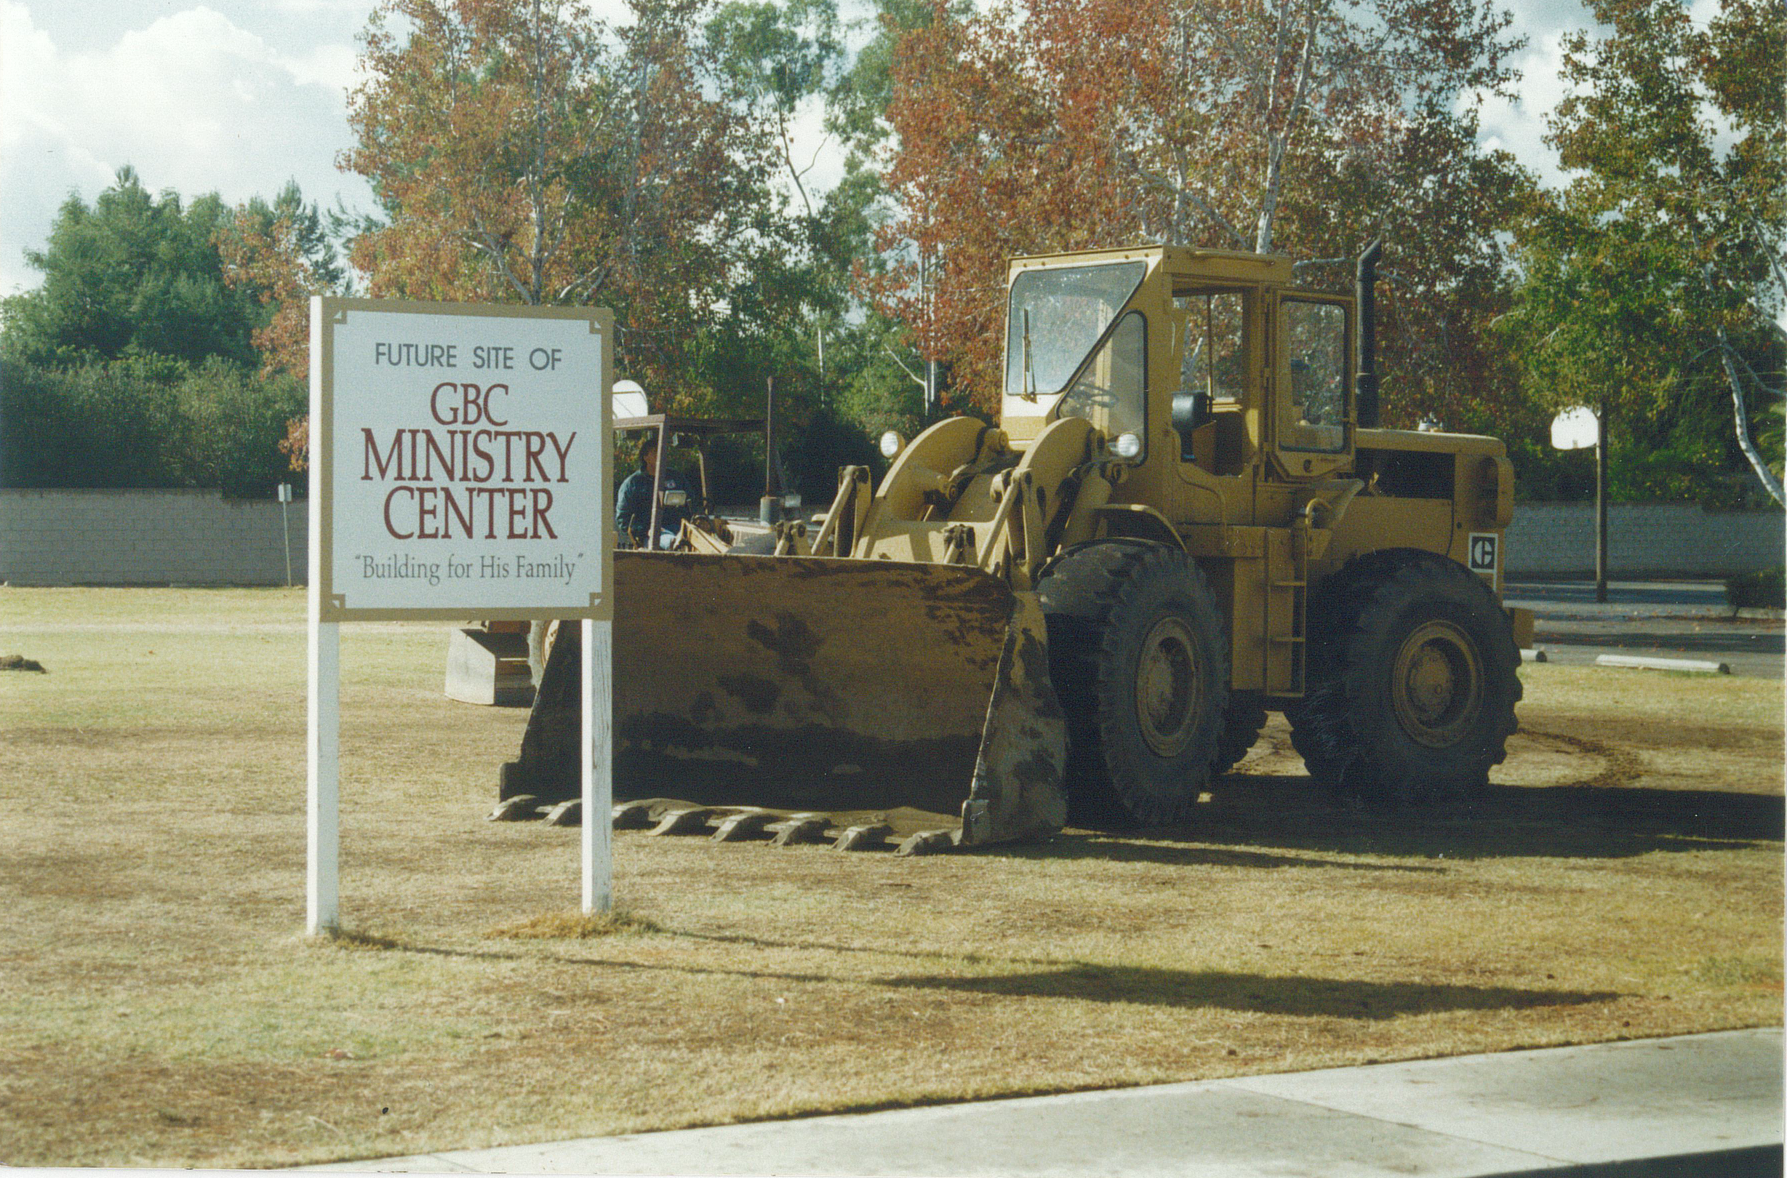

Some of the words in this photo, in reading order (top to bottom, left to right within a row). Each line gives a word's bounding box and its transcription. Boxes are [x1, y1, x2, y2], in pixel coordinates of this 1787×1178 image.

[375, 342, 457, 368] FUTURE
[473, 346, 514, 370] SITE
[529, 348, 562, 371] OF
[430, 382, 509, 426] GBC
[361, 428, 577, 483] MINISTRY
[384, 485, 558, 540] CENTER
[448, 553, 473, 578] for
[480, 555, 510, 578] His
